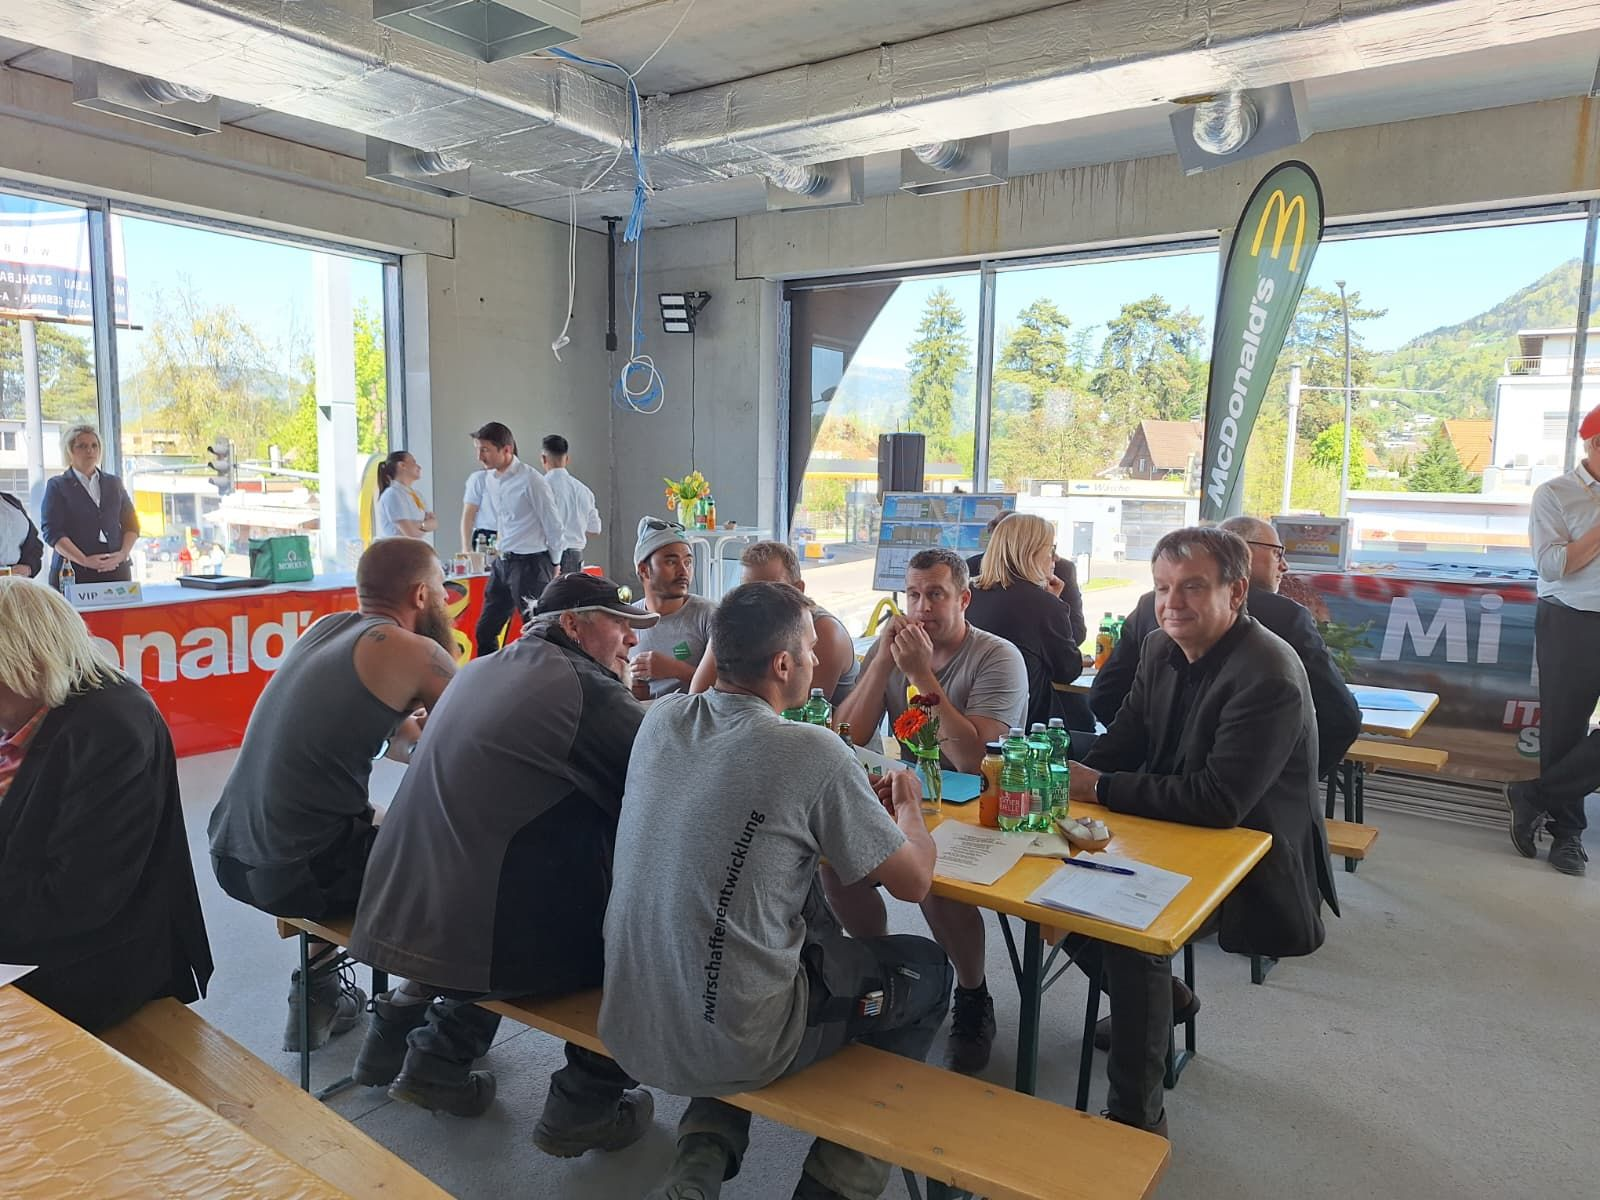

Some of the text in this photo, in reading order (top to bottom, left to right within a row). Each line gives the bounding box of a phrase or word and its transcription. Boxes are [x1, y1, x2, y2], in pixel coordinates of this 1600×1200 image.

[1207, 274, 1275, 509] McDonald's
[78, 591, 98, 600] VIP
[703, 810, 765, 1024] #wirschaffenentwicklung
